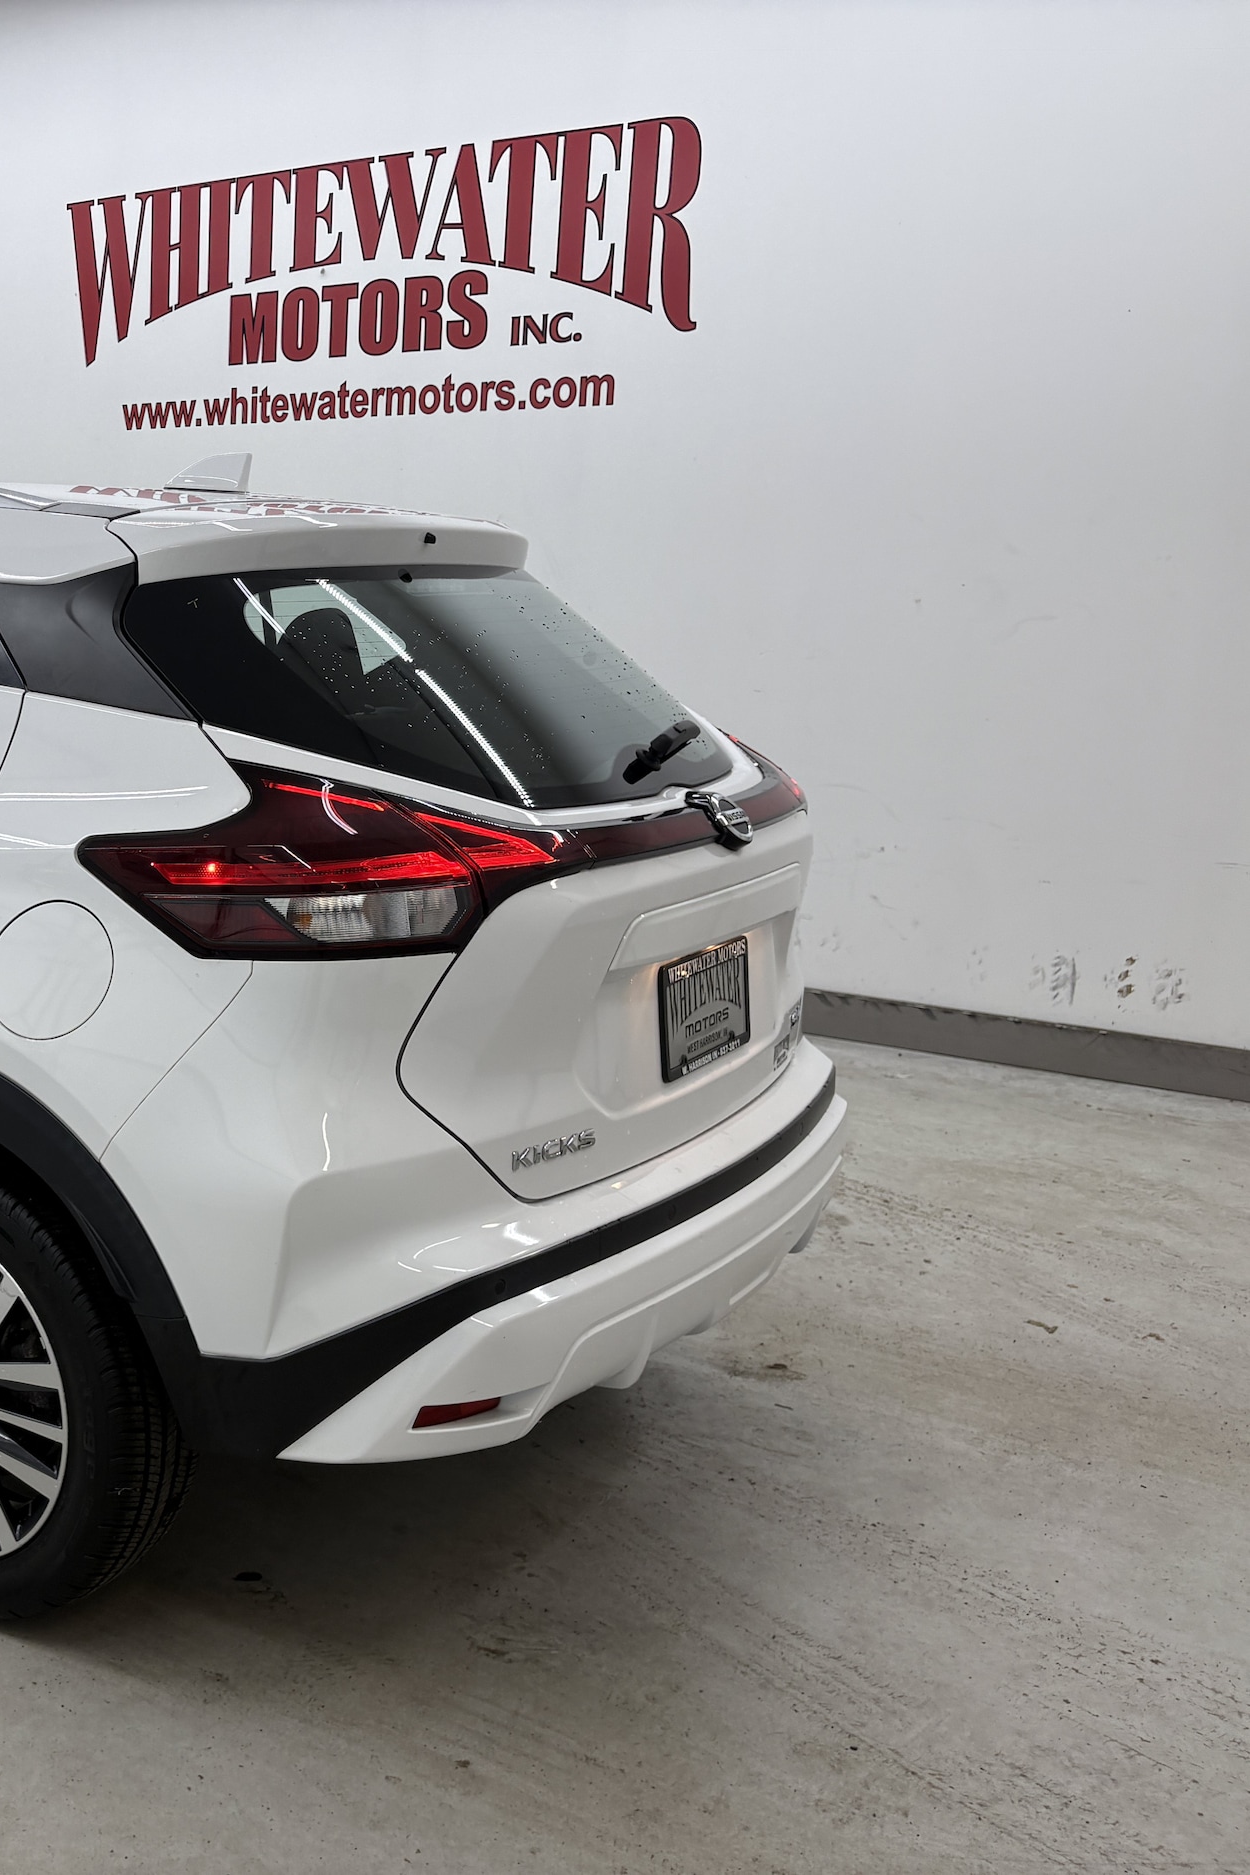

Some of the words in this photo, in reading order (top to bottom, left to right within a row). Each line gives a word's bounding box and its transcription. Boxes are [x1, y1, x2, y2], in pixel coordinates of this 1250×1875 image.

[66, 115, 703, 368] WHITEWATER
[228, 270, 490, 367] MOTORS
[509, 312, 583, 347] INC.
[121, 373, 616, 431] www.whitewatermotors.com
[722, 811, 745, 822] NISSA
[668, 951, 717, 983] WHITEWATER
[717, 939, 746, 963] MOTORS
[666, 957, 742, 1040] WHITEWATER
[685, 1007, 730, 1038] MOTORS
[688, 1053, 712, 1073] HARRISON
[511, 1128, 596, 1173] KICKS
